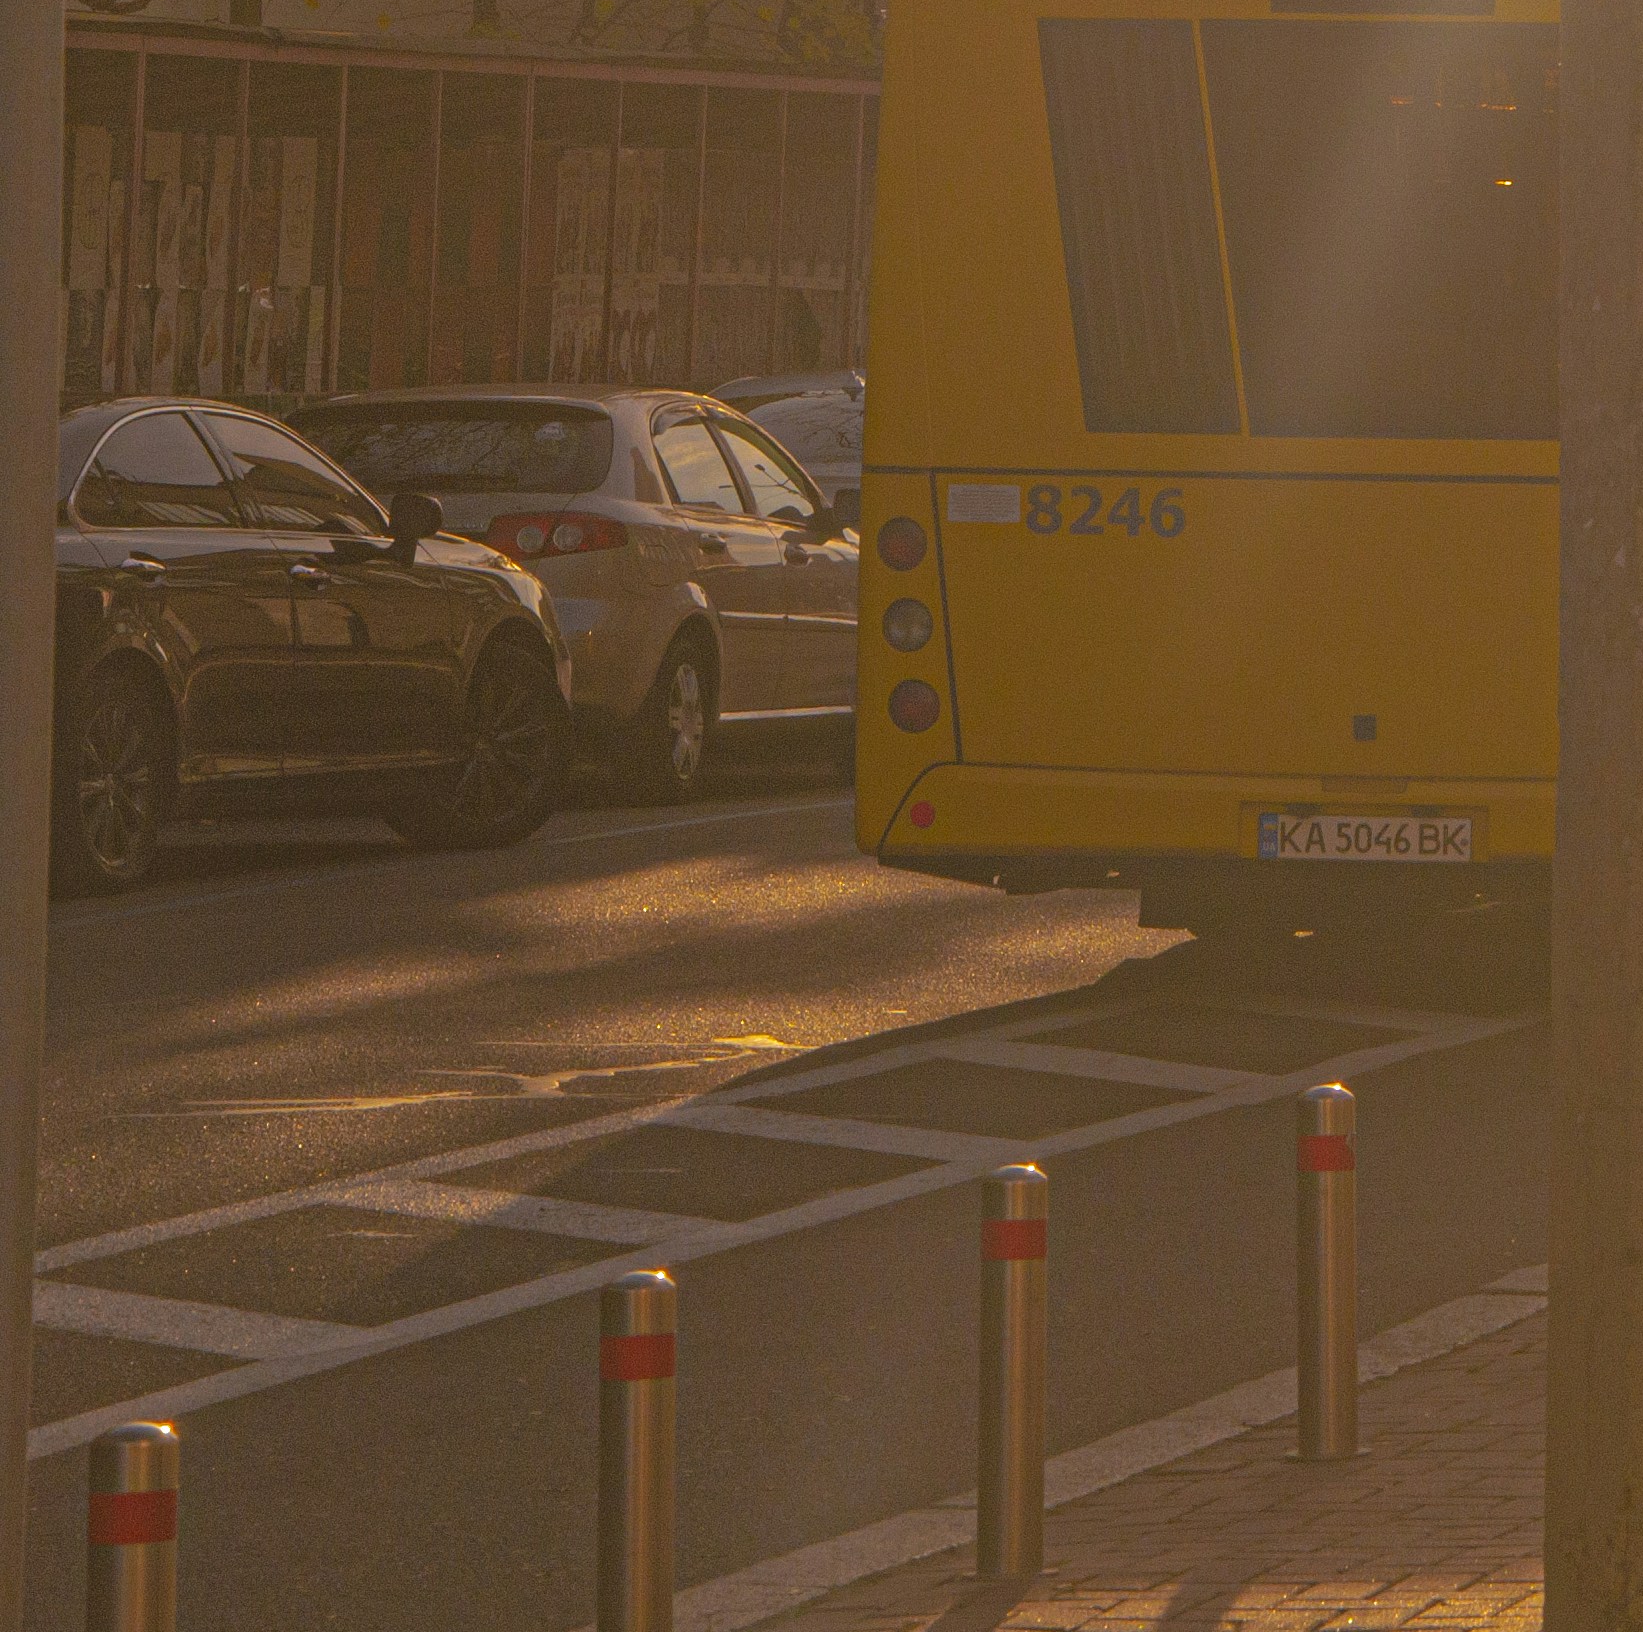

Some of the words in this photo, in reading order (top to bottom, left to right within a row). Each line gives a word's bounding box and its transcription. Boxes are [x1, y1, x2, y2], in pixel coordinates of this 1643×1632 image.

[1026, 484, 1186, 538] 8246
[1279, 821, 1327, 853] KA
[1335, 822, 1412, 854] 5046
[1418, 824, 1465, 856] BK
